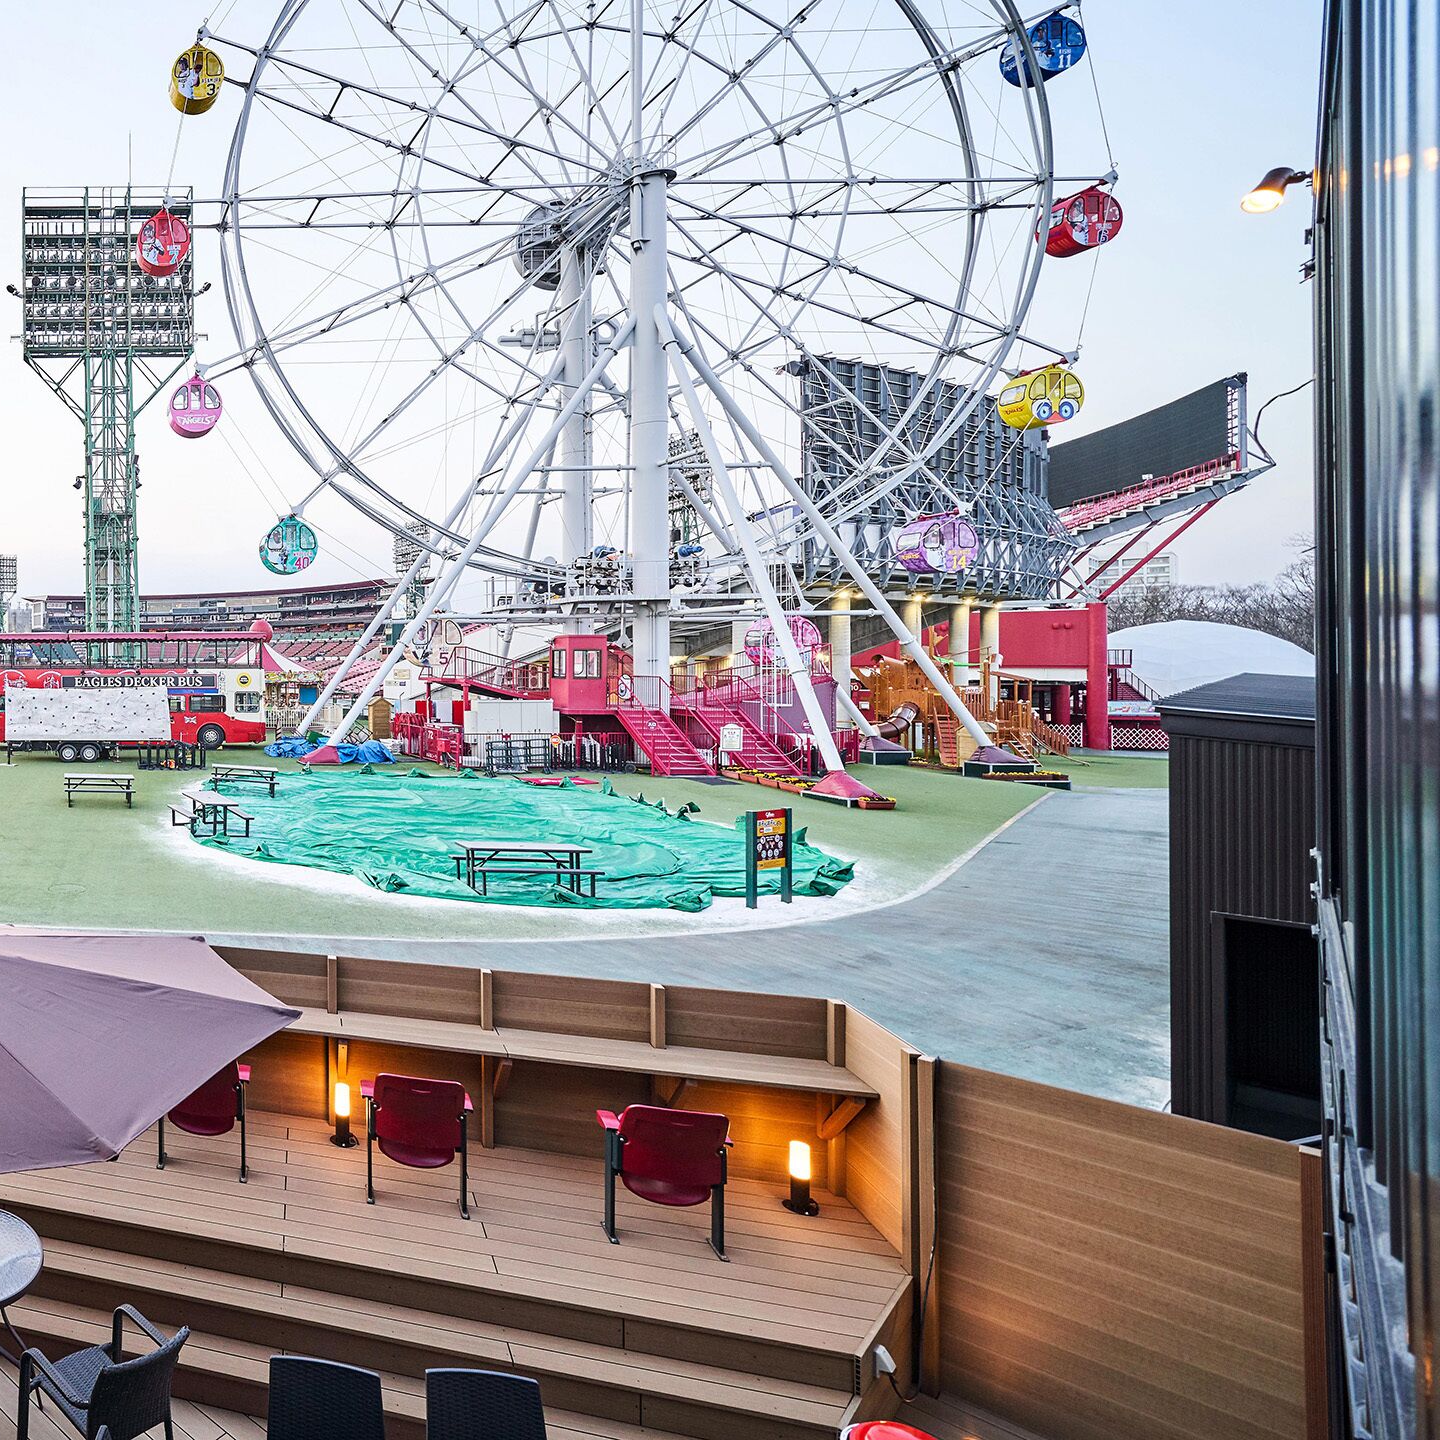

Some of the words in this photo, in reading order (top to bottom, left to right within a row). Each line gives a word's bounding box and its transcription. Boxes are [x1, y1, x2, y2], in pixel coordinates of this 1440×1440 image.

[1058, 54, 1071, 68] 11
[206, 83, 216, 96] 3
[169, 250, 179, 264] 7
[295, 556, 310, 570] 40
[952, 555, 967, 569] 14
[439, 651, 449, 665] 5
[74, 677, 122, 687] EAGLES
[128, 677, 178, 687] DECKER
[179, 676, 203, 686] BUS
